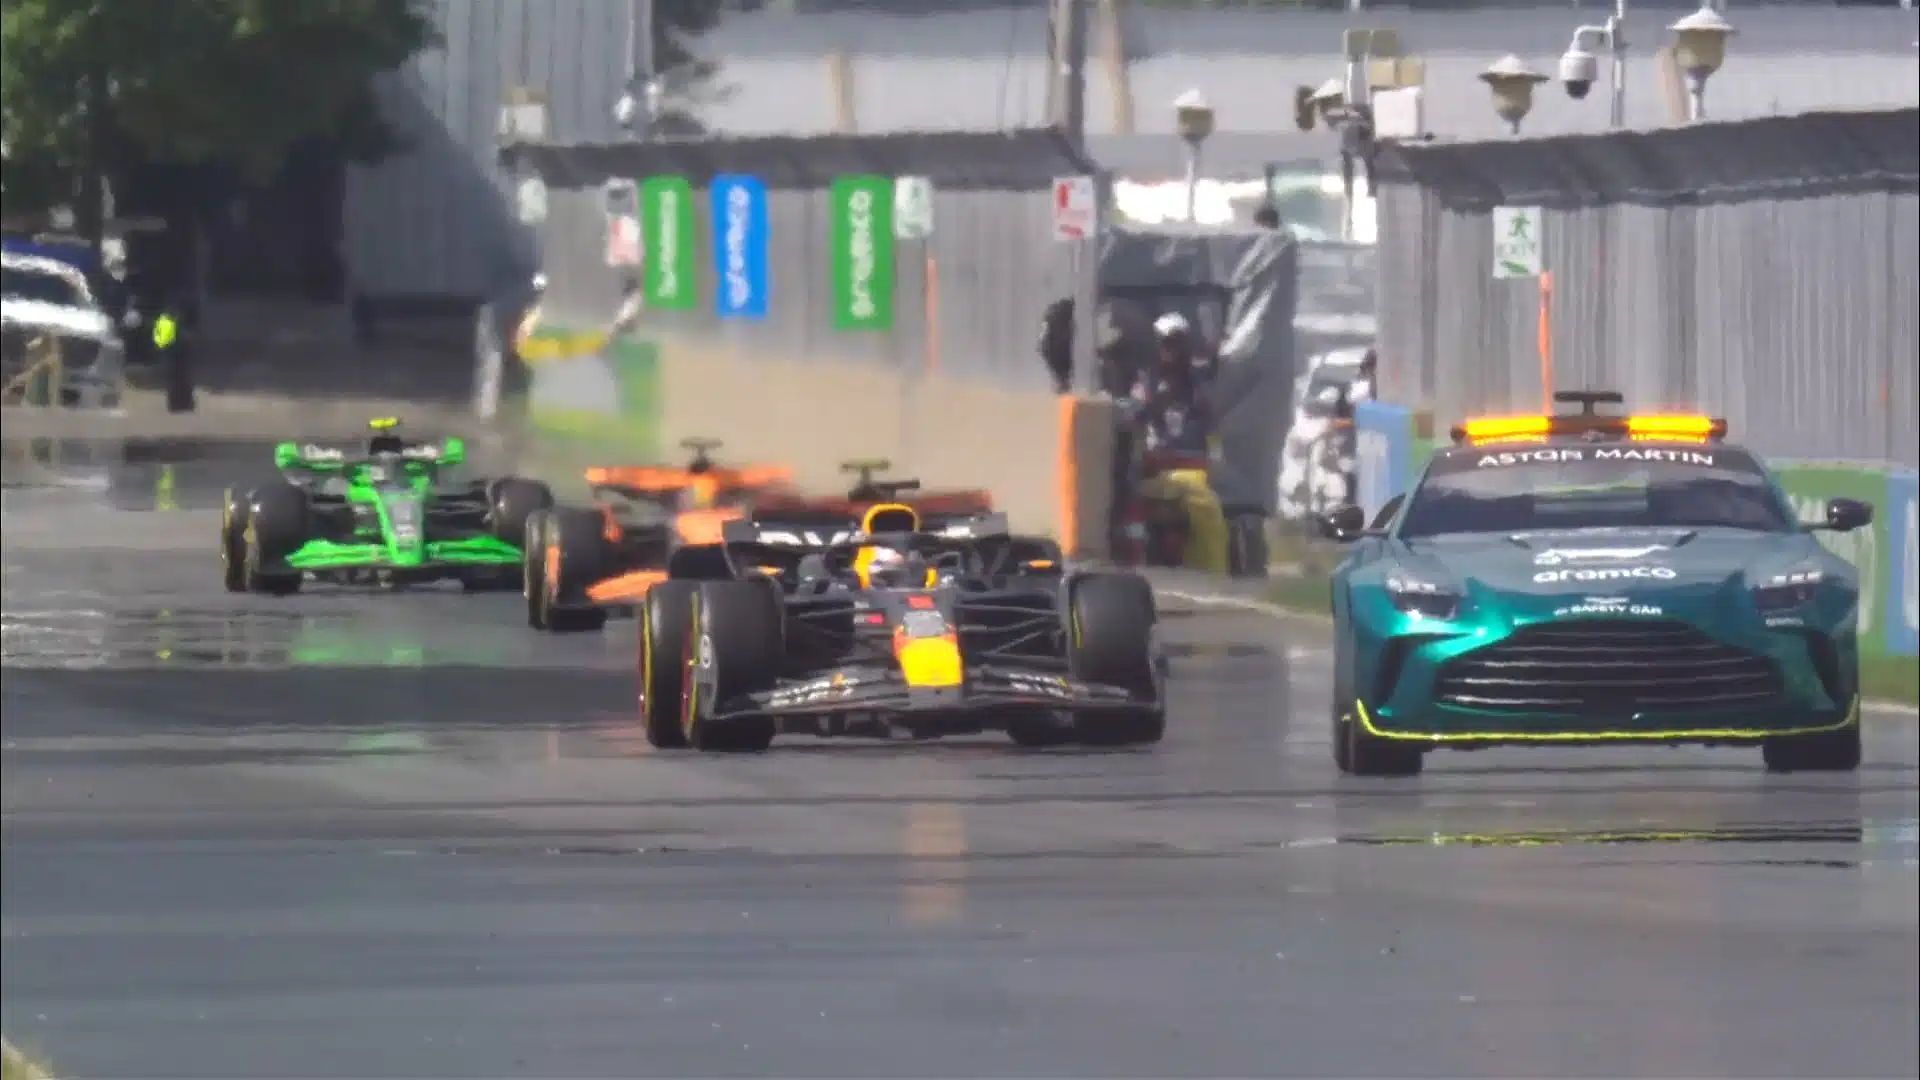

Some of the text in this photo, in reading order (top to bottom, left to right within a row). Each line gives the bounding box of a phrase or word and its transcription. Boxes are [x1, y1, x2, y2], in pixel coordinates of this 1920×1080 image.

[1477, 448, 1714, 467] ASTON MARTIN
[1533, 566, 1677, 583] aramco
[1570, 603, 1627, 613] SAFETY
[1629, 603, 1663, 615] CAR
